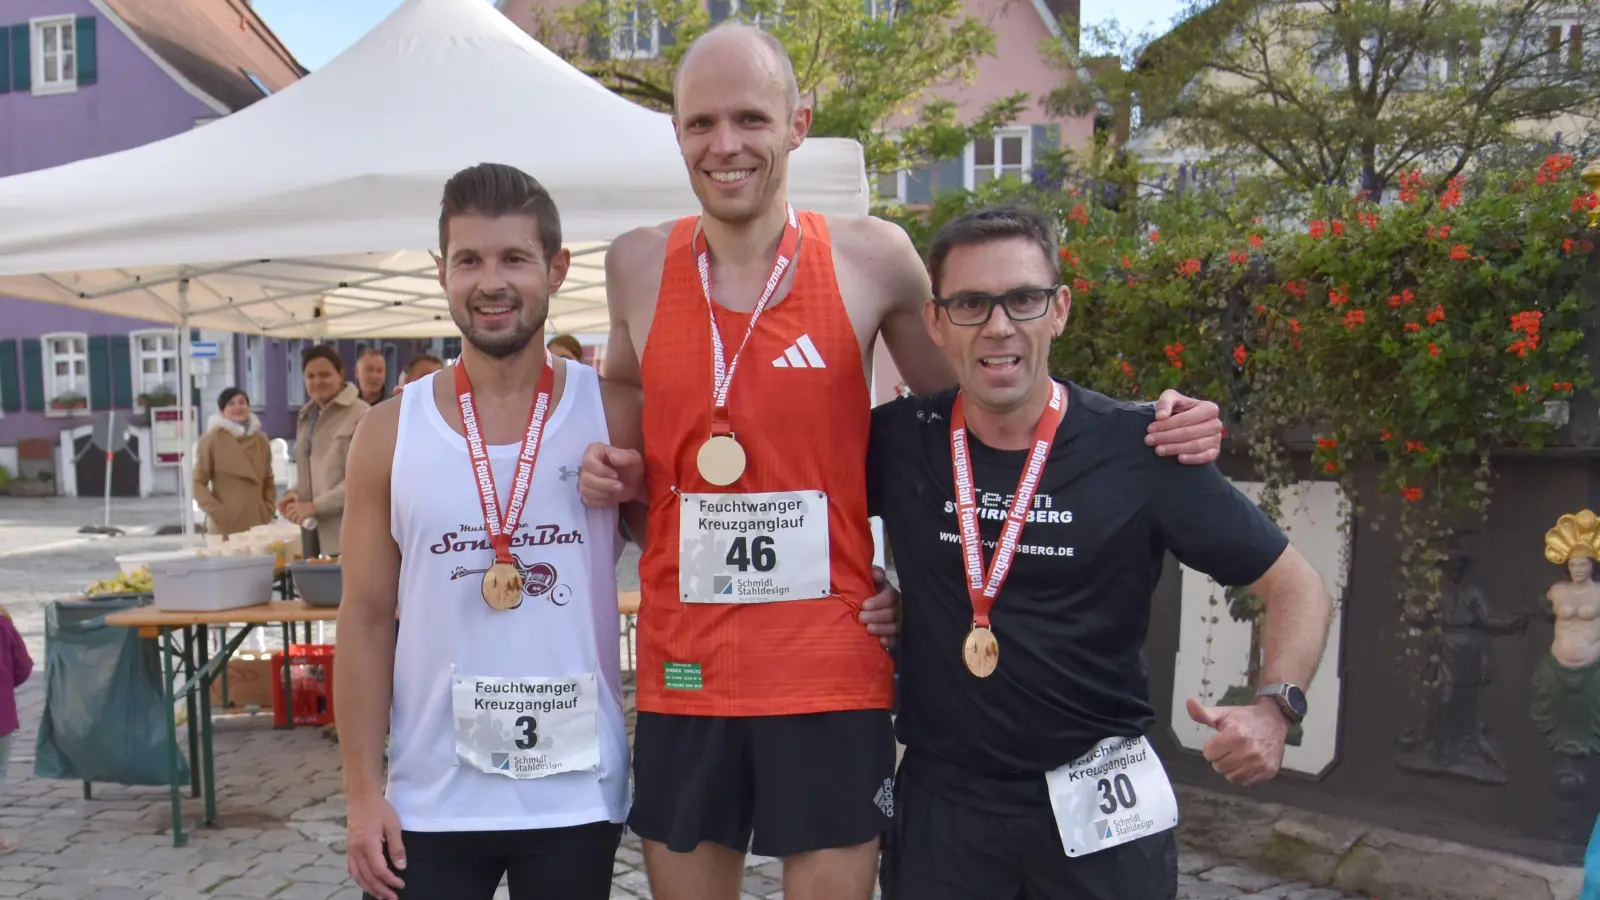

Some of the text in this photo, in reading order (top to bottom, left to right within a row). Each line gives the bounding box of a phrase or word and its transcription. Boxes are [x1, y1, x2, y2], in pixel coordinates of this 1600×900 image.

[750, 254, 789, 329] Kreuzganglauf
[459, 391, 502, 536] Kreuzganglauf Feuchtwangen
[502, 391, 550, 536] Kreuzganglauf Feuchtwangen
[699, 499, 803, 514] Feuchtwanger
[952, 427, 983, 589] Kreuzganglauf Feuchtwangen
[983, 439, 1050, 598] Kreuzganglauf Feuchtwangen
[698, 515, 805, 533] Kreuzganglauf
[725, 535, 777, 572] 46
[737, 578, 773, 587] Schmidl
[737, 586, 790, 596] Stahldesign
[475, 681, 577, 696] Feuchtwanger
[474, 697, 578, 713] Kreuzganglauf
[514, 715, 538, 750] 3
[513, 754, 547, 765] Schmidl
[514, 762, 563, 772] Stahldesign
[1068, 748, 1147, 782] Kreuzganglauf
[883, 777, 894, 818] adidas
[1097, 773, 1137, 815] 30
[1113, 813, 1141, 828] Schmidl
[1115, 819, 1154, 836] Stahldesign
